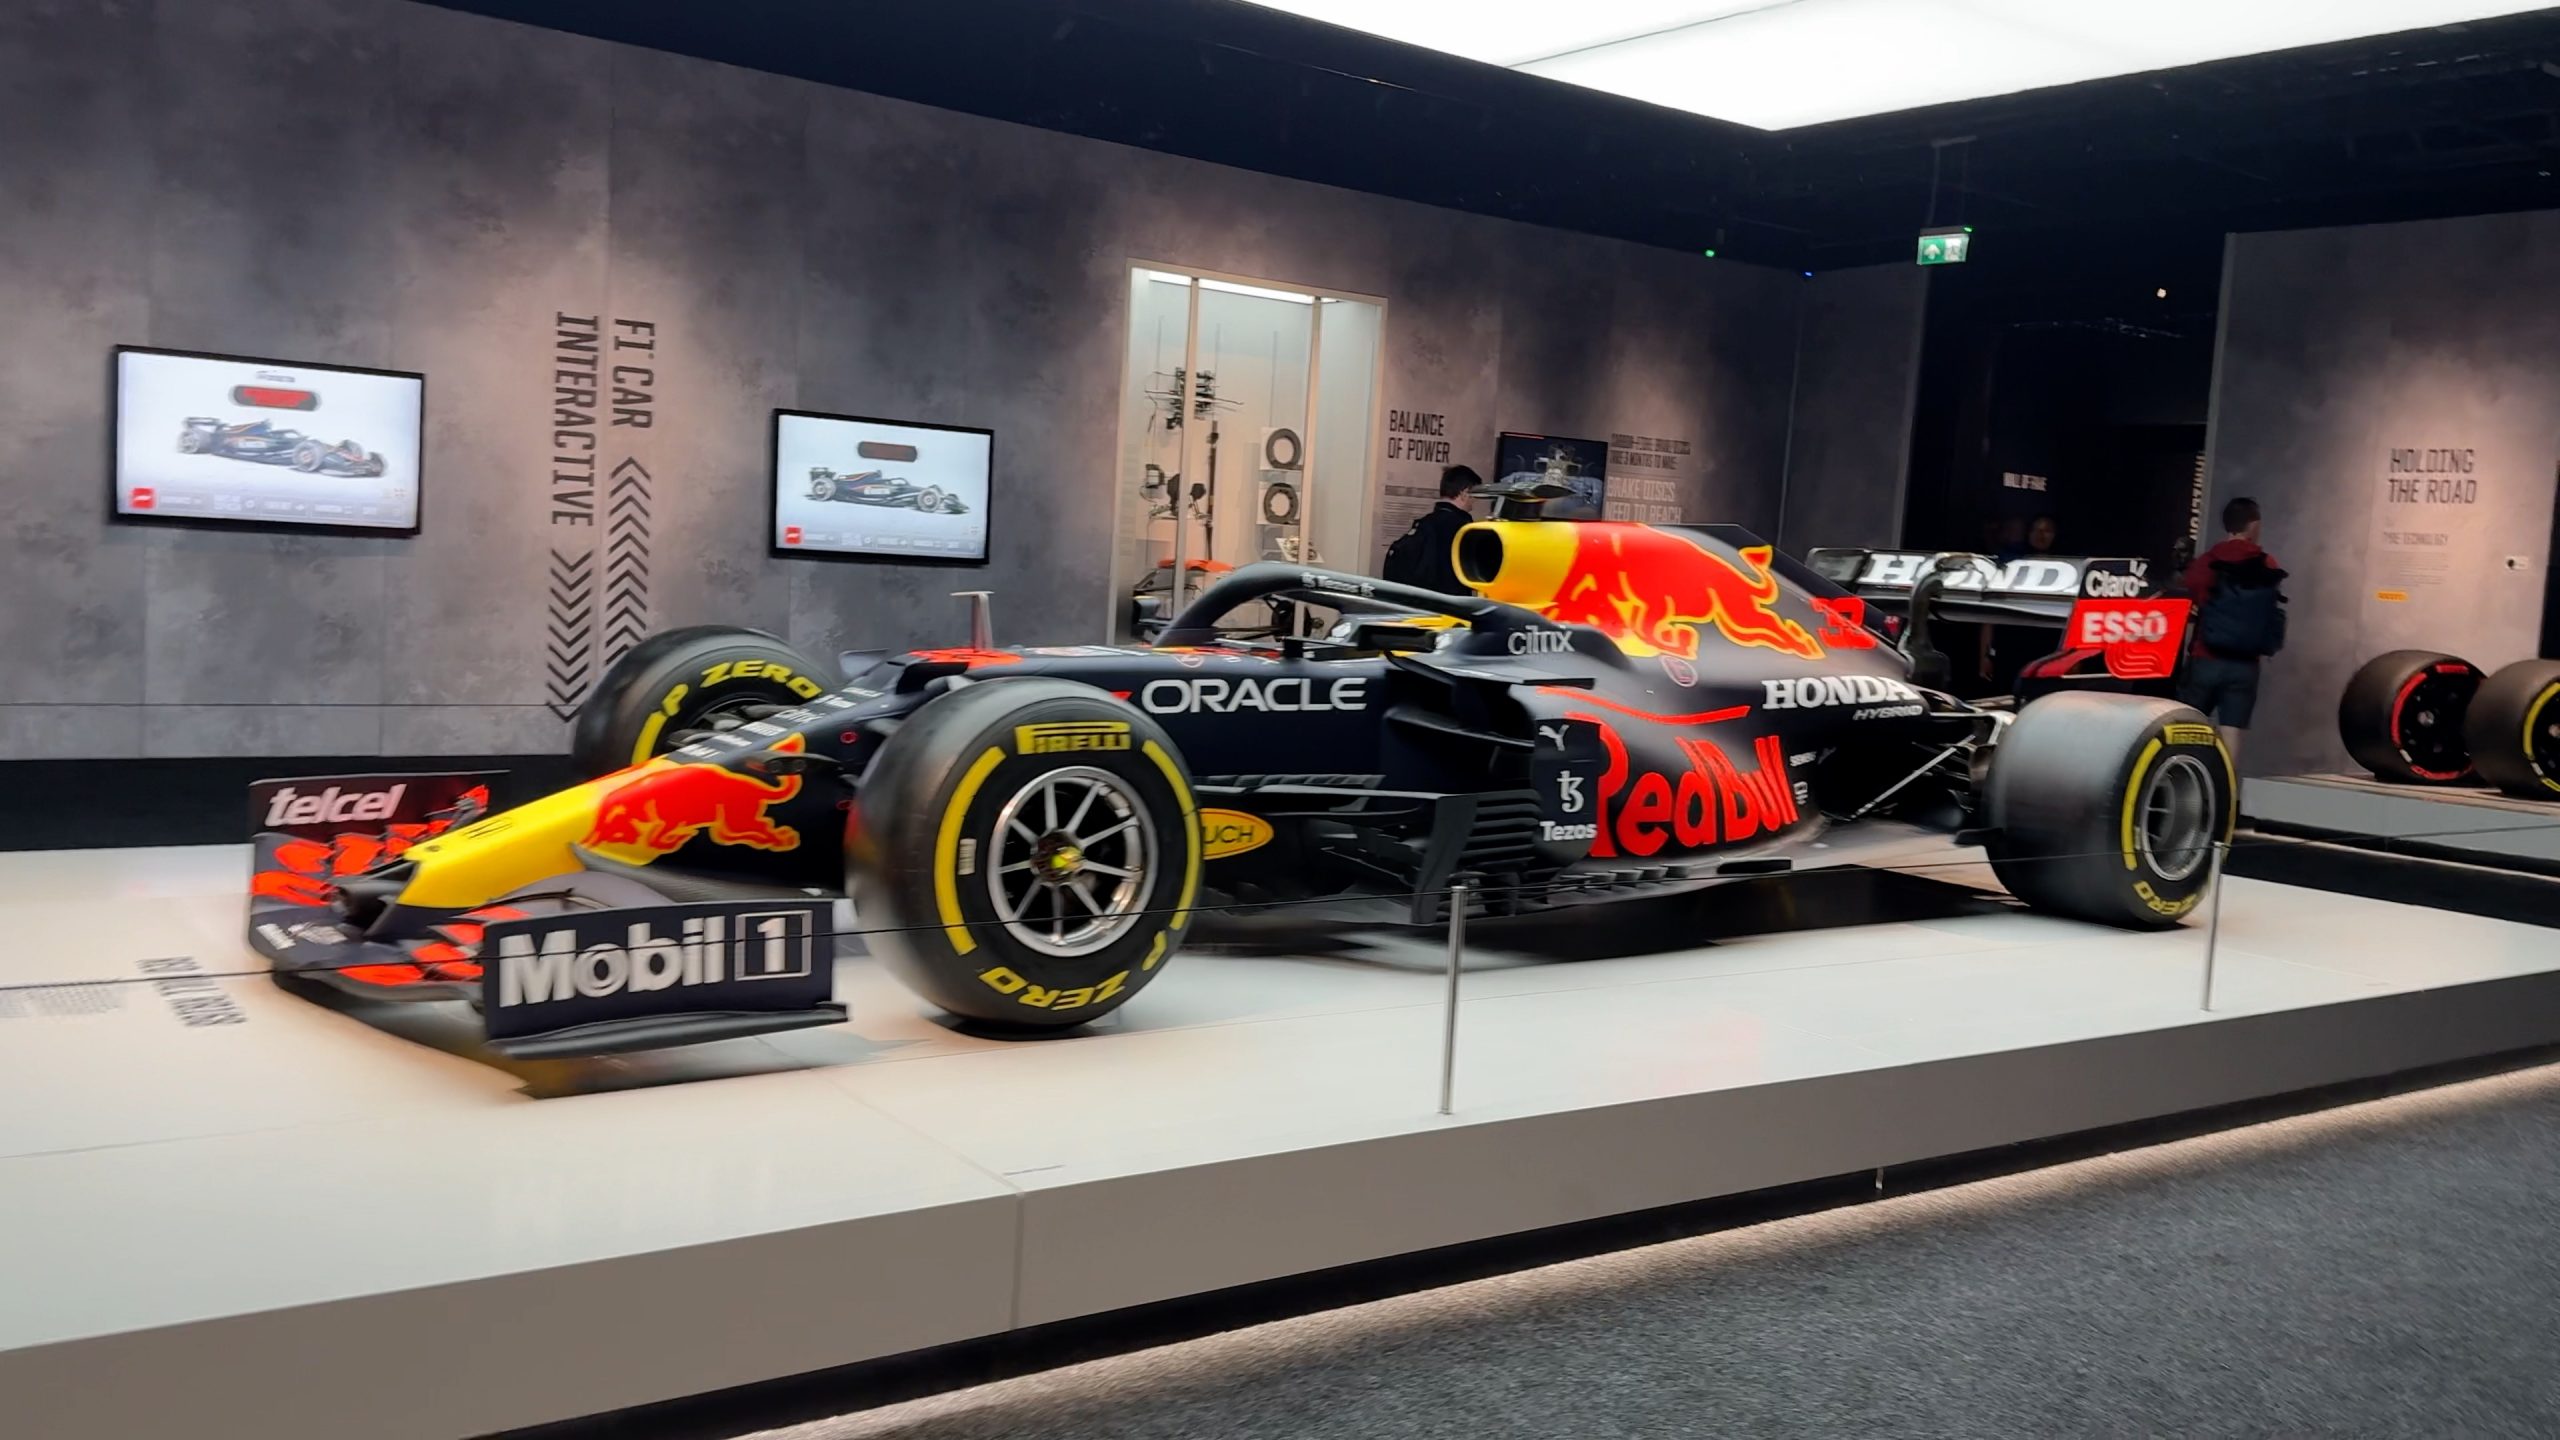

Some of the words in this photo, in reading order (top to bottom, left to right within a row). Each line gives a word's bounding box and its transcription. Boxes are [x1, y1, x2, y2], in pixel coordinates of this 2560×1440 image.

[611, 365, 655, 428] CAR
[551, 311, 600, 526] INTERACTIVE
[1389, 410, 1445, 436] BALANCE
[1387, 437, 1403, 459] OF
[1407, 439, 1450, 464] POWER
[2389, 449, 2475, 473] HOLDING
[1607, 476, 1640, 499] BRAKE
[1642, 480, 1677, 502] DISCS
[2387, 479, 2421, 503] THE
[2426, 479, 2478, 504] ROAD
[2085, 568, 2141, 598] Claro
[2081, 609, 2168, 644] ESSO
[700, 659, 822, 699] ZERO
[1142, 676, 1367, 714] ORACLE
[1762, 675, 1921, 710] HONDA
[1853, 704, 1923, 721] HYBRID
[1014, 721, 1131, 755] PIRELLI
[265, 784, 408, 827] telcel
[1202, 825, 1255, 844] UCH
[1539, 820, 1598, 841] Tezos
[499, 915, 726, 1008] Mobil
[978, 966, 1131, 1011] ZERO
